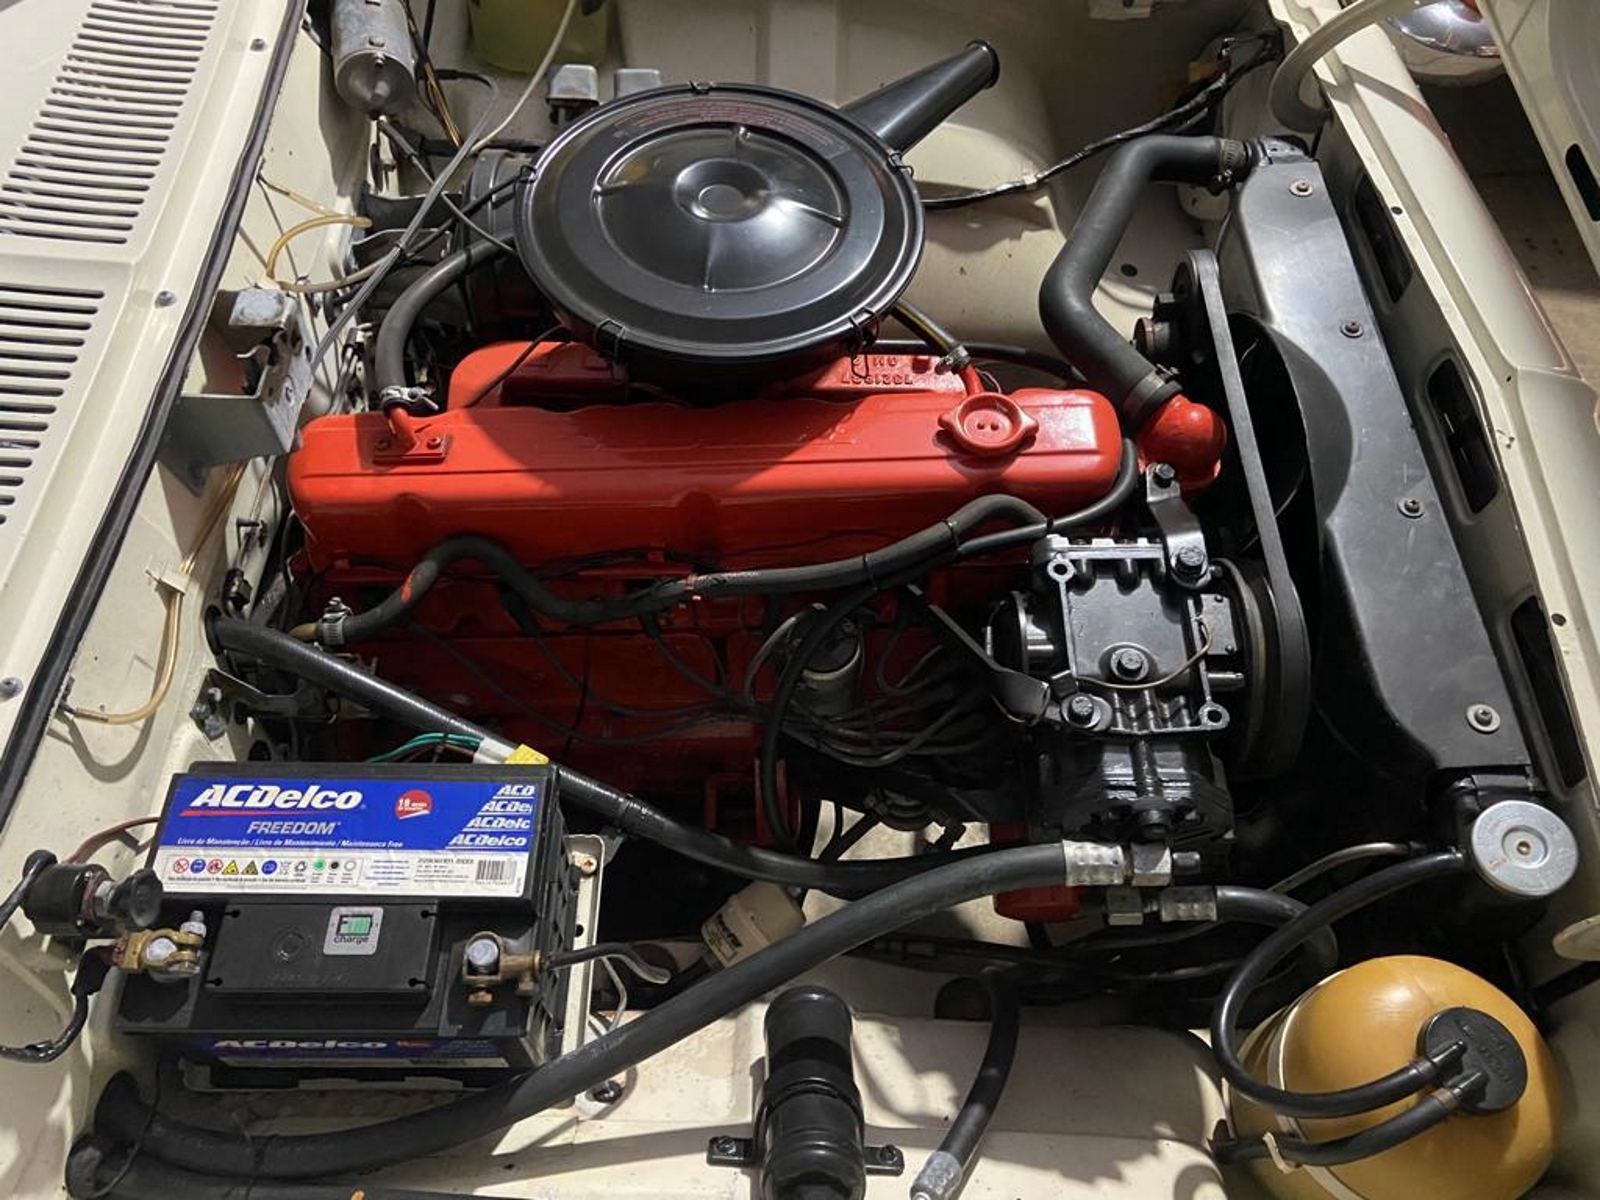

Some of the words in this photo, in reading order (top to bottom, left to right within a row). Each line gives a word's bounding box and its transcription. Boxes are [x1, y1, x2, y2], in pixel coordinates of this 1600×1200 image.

[497, 784, 535, 796] ACD
[189, 785, 363, 809] ACDelco
[246, 821, 336, 834] FREEDOM
[448, 833, 527, 847] ACDelco
[213, 1040, 388, 1049] ACDelco
